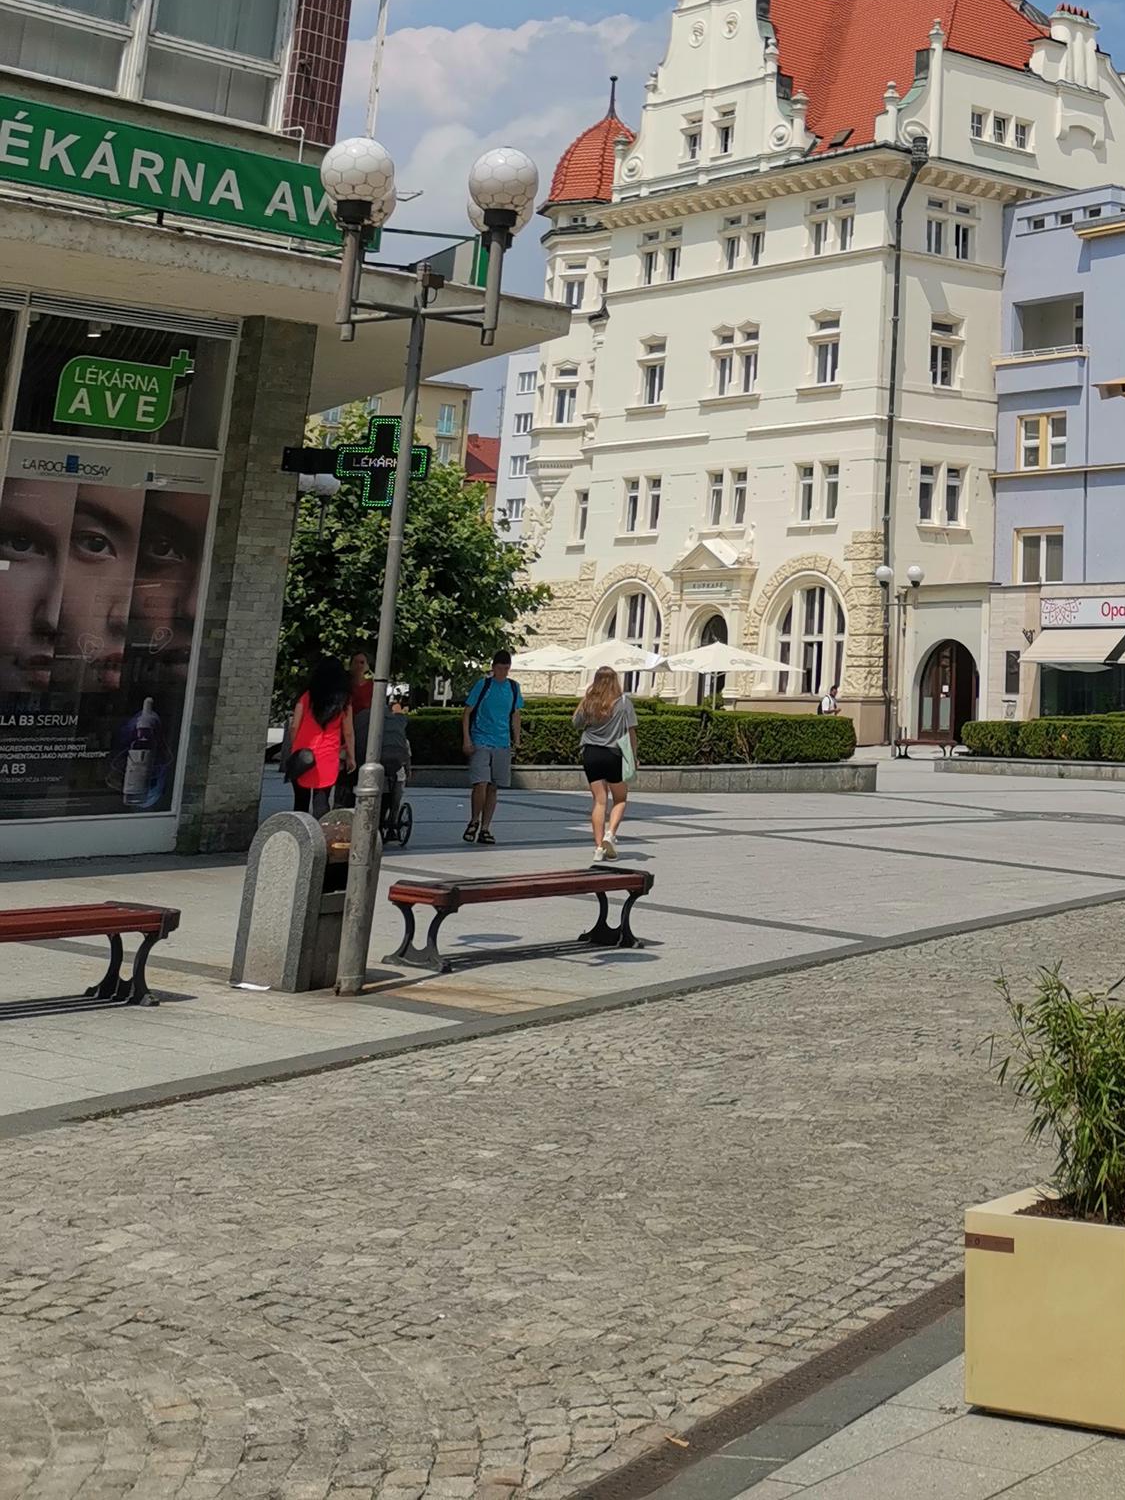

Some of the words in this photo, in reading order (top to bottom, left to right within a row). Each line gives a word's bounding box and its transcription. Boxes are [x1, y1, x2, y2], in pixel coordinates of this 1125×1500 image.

[264, 181, 343, 231] AV
[74, 365, 160, 393] LÉKÁRNA
[68, 387, 157, 423] AVE
[0, 715, 16, 726] LA
[19, 715, 34, 726] B3
[36, 715, 79, 726] SERUM
[11, 763, 26, 774] B3
